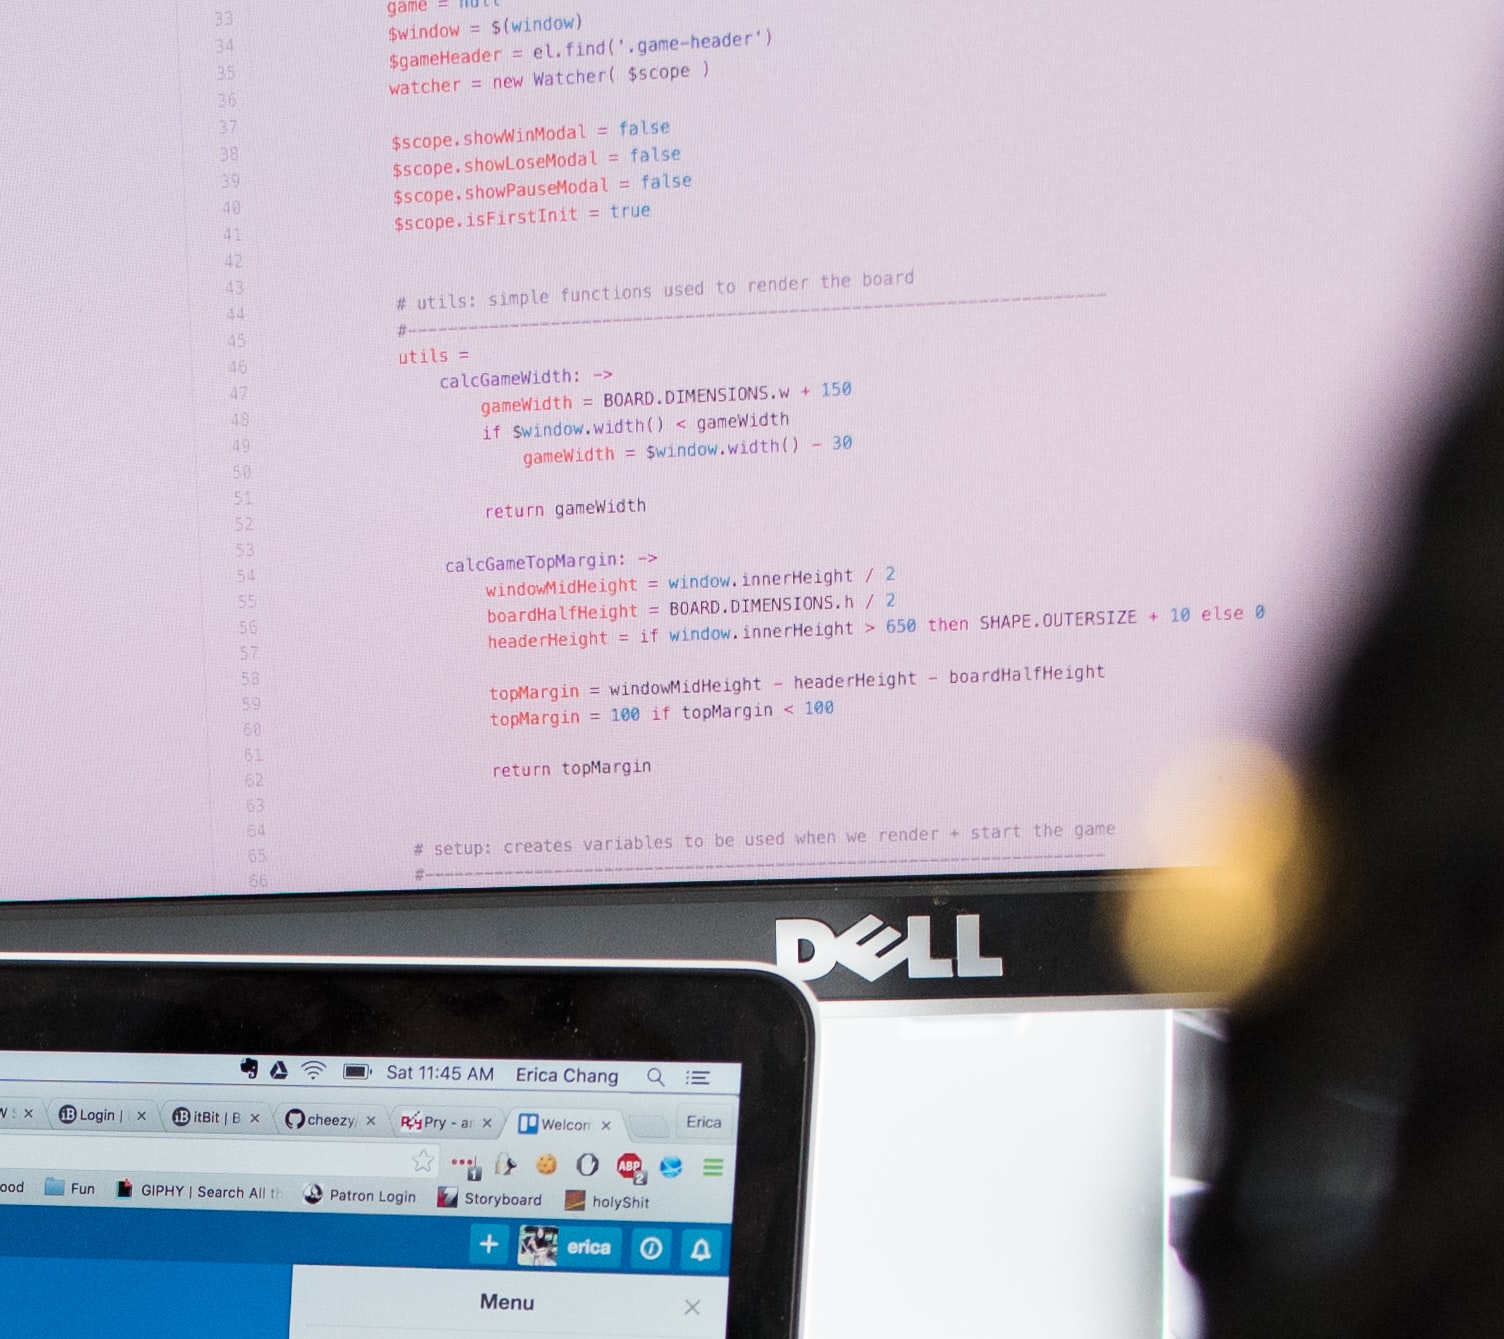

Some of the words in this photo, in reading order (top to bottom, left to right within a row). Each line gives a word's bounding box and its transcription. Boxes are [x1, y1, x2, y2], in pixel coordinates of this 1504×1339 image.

[388, 23, 460, 43] $window
[491, 13, 581, 35] $(window)
[391, 123, 586, 152] $scope.showWinModal
[619, 119, 670, 136] false
[396, 296, 406, 311] #
[417, 293, 475, 310] utils:
[488, 288, 549, 308] simple
[561, 284, 651, 302] functions
[664, 280, 704, 297] used
[716, 279, 736, 294] to
[748, 276, 809, 292] render
[820, 273, 851, 289] the
[862, 268, 914, 287] board
[480, 394, 572, 417] gameWidth
[603, 385, 790, 408] BOARD.DIMENSIONS.w
[822, 380, 852, 397] 150
[486, 504, 544, 519] return
[555, 497, 646, 519] gameWidth
[445, 551, 624, 573] calcGameTopMargin:
[488, 630, 607, 649] headerHeight
[640, 628, 658, 643] if
[669, 621, 853, 642] window.innerHeight
[886, 617, 916, 633] 650
[928, 617, 968, 632] then
[980, 609, 1137, 630] SHAPE.OUTERSIZE
[1170, 606, 1191, 622] 10
[1201, 606, 1243, 621] else
[493, 764, 550, 777] return
[562, 759, 651, 778] topMargin
[775, 913, 1003, 982] DELL
[386, 1064, 413, 1079] Sat
[419, 1065, 461, 1081] 11:45
[466, 1066, 494, 1081] AM
[516, 1066, 557, 1082] Erica
[563, 1067, 618, 1087] Chang
[686, 1114, 722, 1128] Erica
[71, 1182, 95, 1194] Fun
[330, 1188, 374, 1202] Patron
[378, 1190, 416, 1205] Login
[464, 1192, 542, 1207] Storyboard
[592, 1195, 649, 1211] holyShit
[567, 1240, 612, 1255] erica
[480, 1292, 534, 1310] Menu
